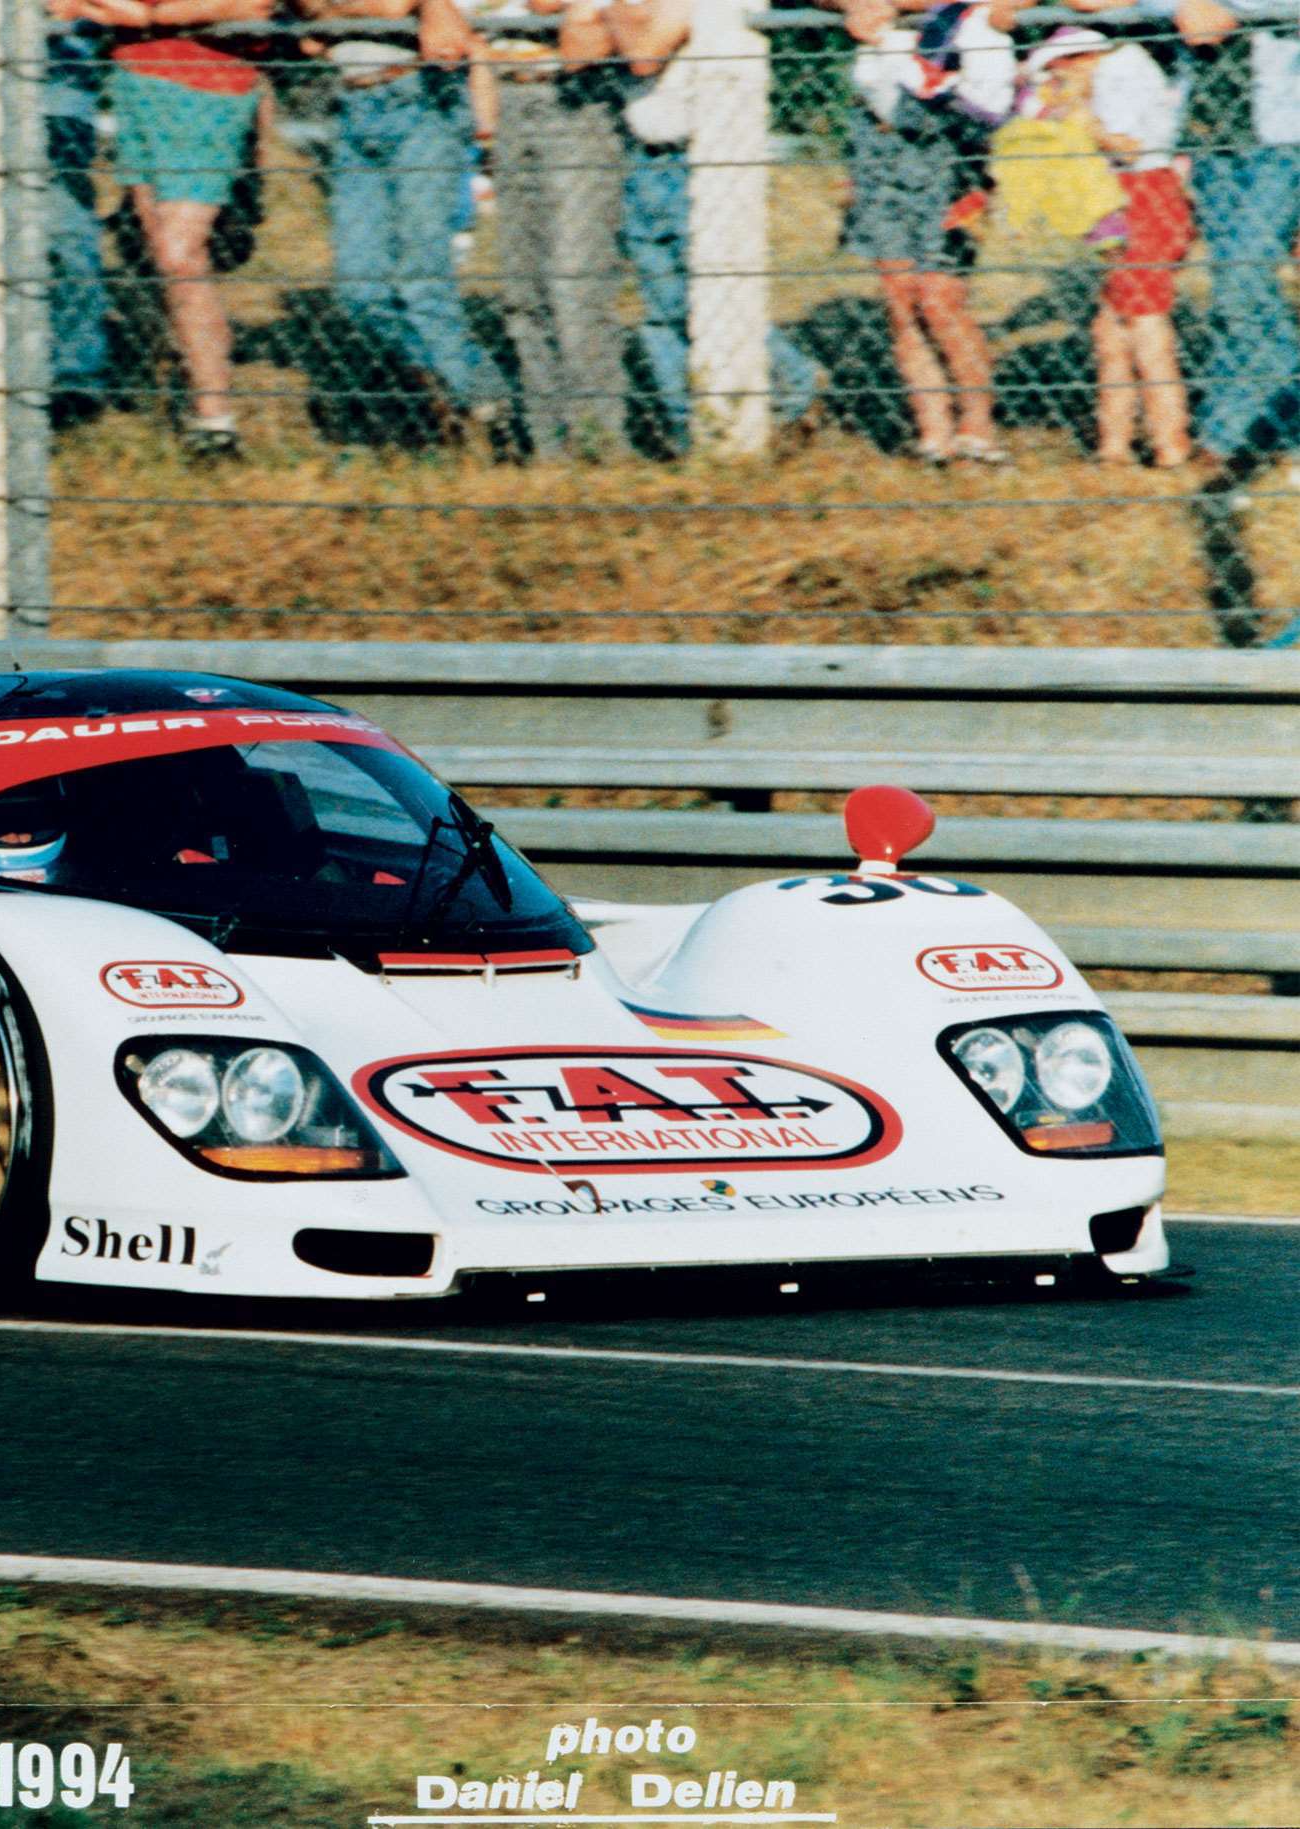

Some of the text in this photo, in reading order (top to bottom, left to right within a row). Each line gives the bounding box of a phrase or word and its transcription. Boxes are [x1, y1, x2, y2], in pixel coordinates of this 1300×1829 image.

[417, 1066, 813, 1124] F.A.T.
[490, 1125, 838, 1153] INTERNATIONAL
[475, 1184, 1005, 1215] GROUPAGES EUROPÉENS
[61, 1215, 196, 1266] Shell
